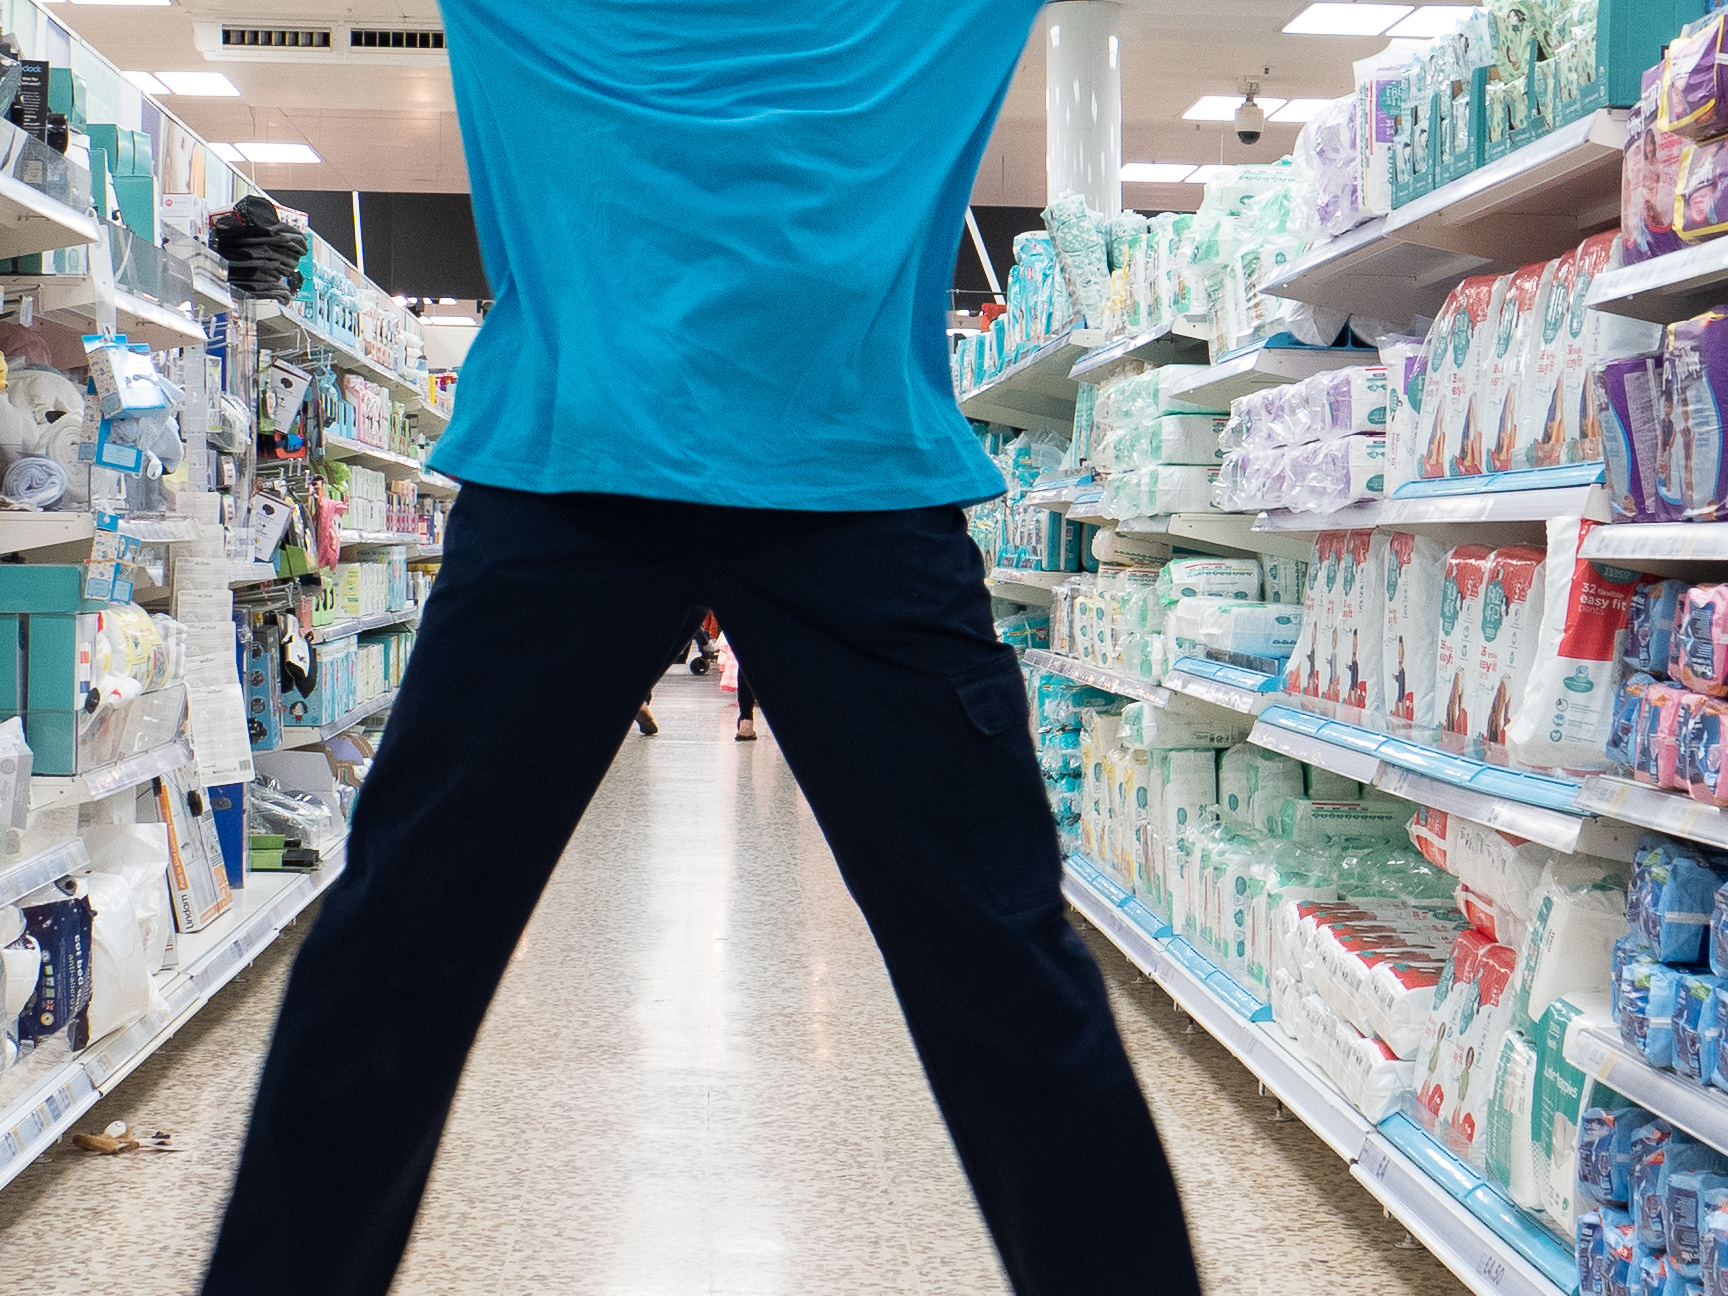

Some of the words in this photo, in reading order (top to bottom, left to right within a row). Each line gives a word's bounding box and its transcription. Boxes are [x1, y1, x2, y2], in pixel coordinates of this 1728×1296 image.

[1581, 581, 1597, 595] 32
[1579, 594, 1610, 610] easy
[1611, 597, 1629, 611] fit
